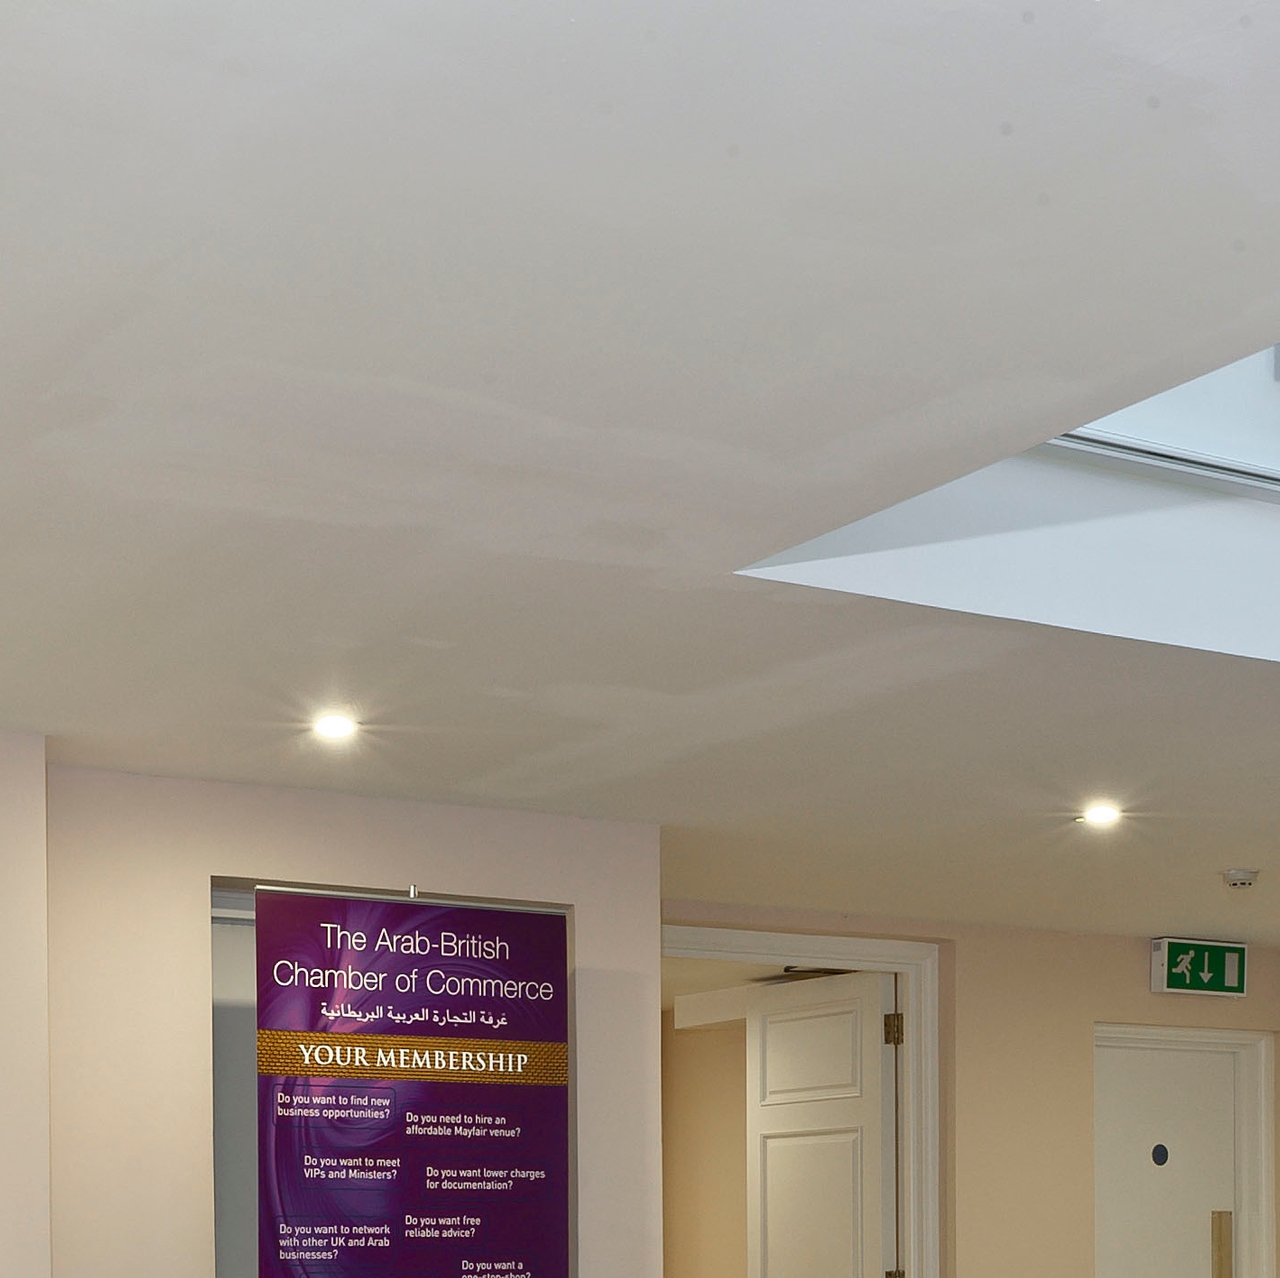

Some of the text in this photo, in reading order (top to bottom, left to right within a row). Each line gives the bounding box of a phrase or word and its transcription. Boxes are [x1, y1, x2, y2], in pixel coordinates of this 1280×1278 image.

[320, 923, 508, 959] The Arab-British
[273, 960, 553, 1000] Chamber of Commerce
[320, 1002, 508, 1029] غرفة التجارة العربية البريطانية
[298, 1044, 528, 1073] YOUR MEMBERSHIP
[277, 1092, 390, 1107] Do you want to find new
[277, 1105, 390, 1119] business opportunities?
[405, 1124, 520, 1138] affordable Mayfair venue?
[304, 1155, 400, 1168] Do you want to meet
[303, 1167, 397, 1179] VIPs and Ministers?
[461, 1259, 474, 1269] Do
[475, 1262, 491, 1274] you
[493, 1260, 515, 1271] want
